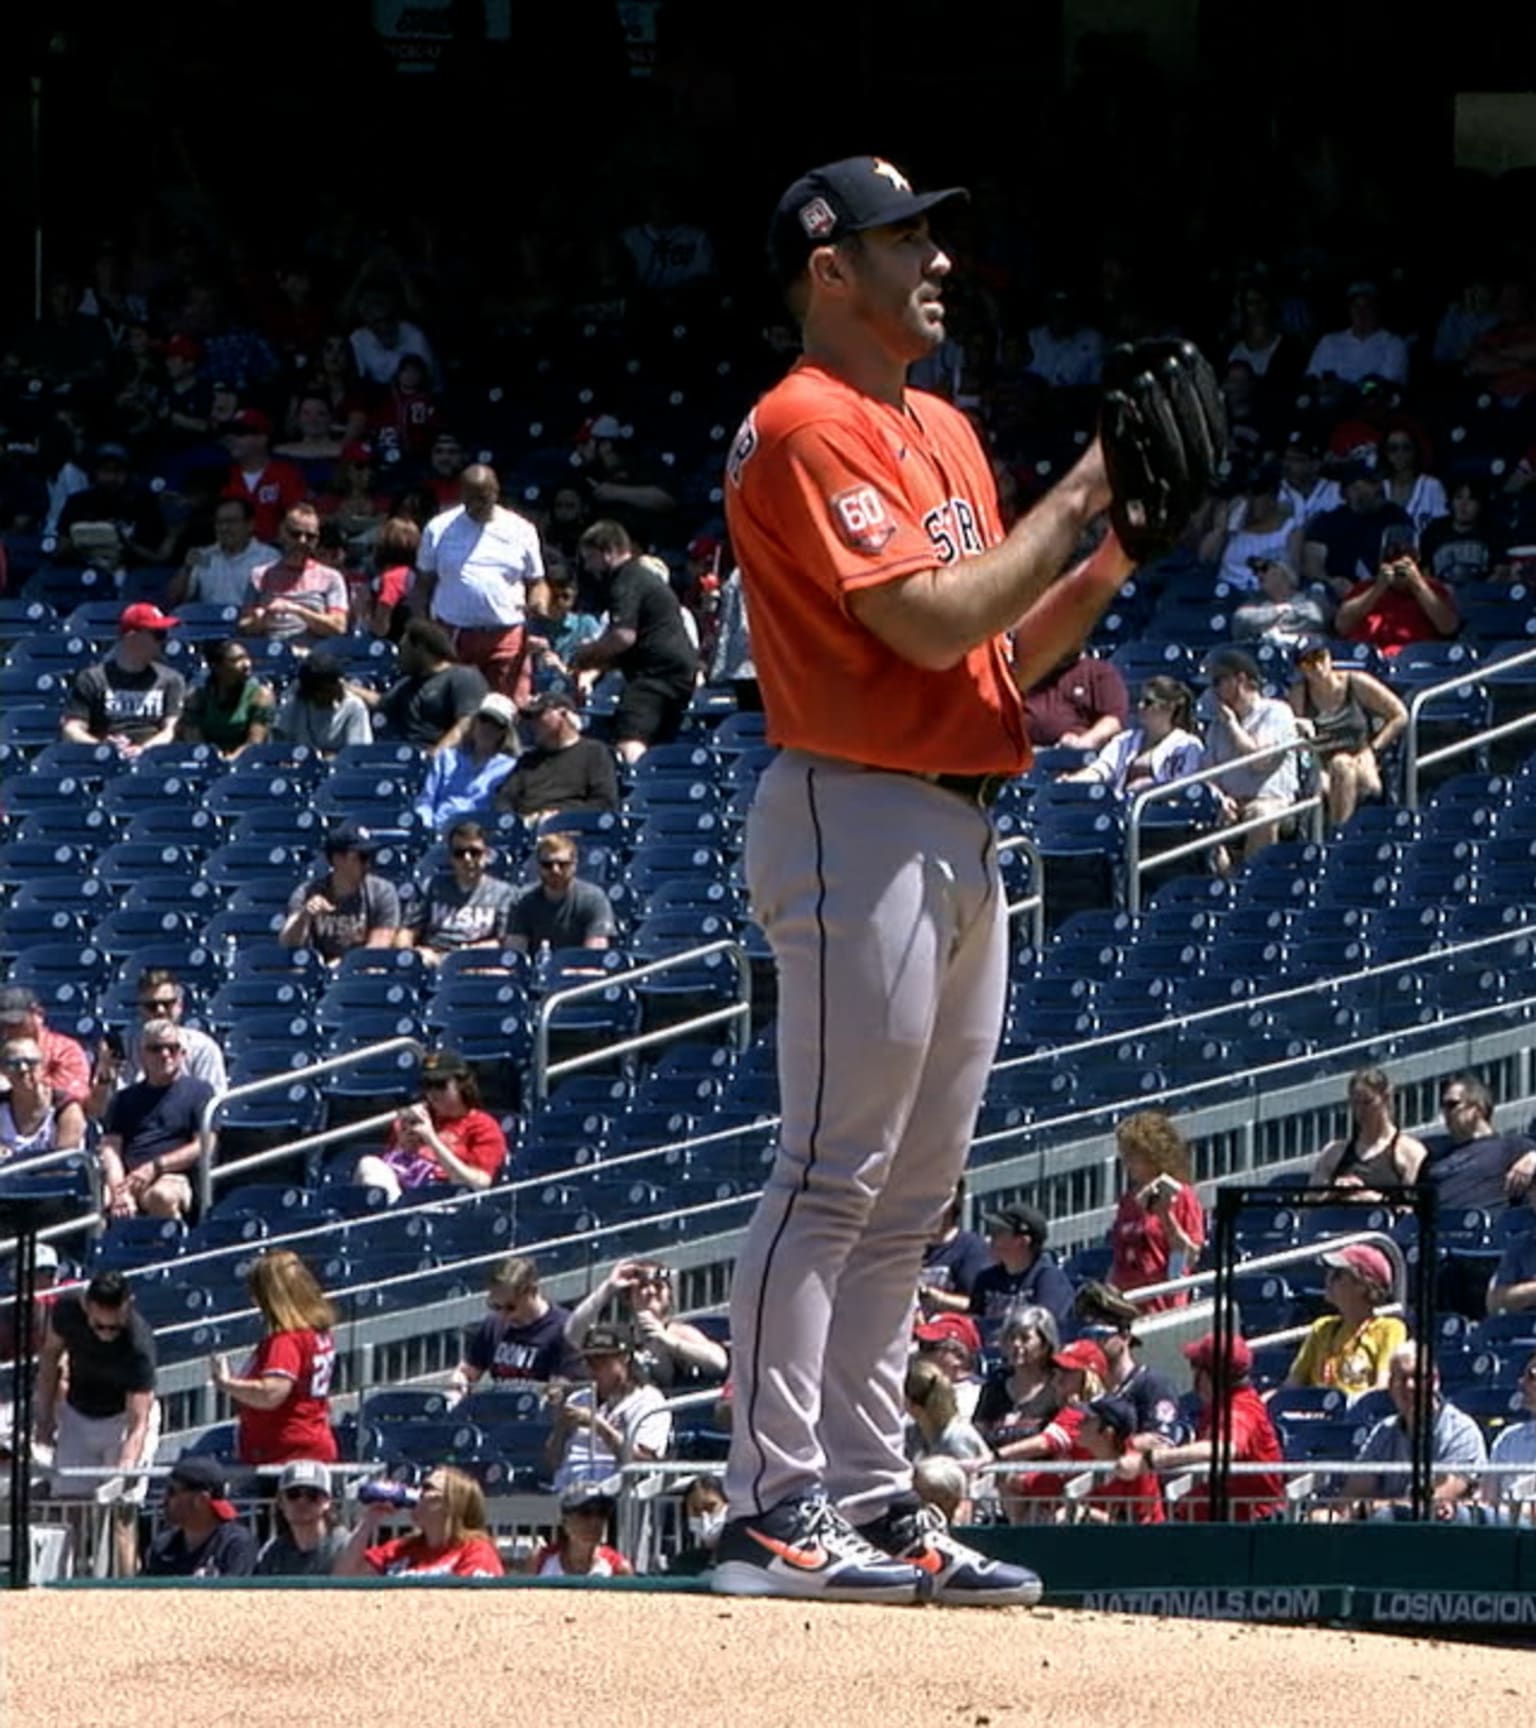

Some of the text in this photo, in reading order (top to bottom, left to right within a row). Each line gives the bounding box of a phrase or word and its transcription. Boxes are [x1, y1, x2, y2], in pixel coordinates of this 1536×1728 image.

[839, 488, 885, 531] 60
[431, 906, 494, 931] WSH
[1081, 1588, 1318, 1618] NATIONALS.COM
